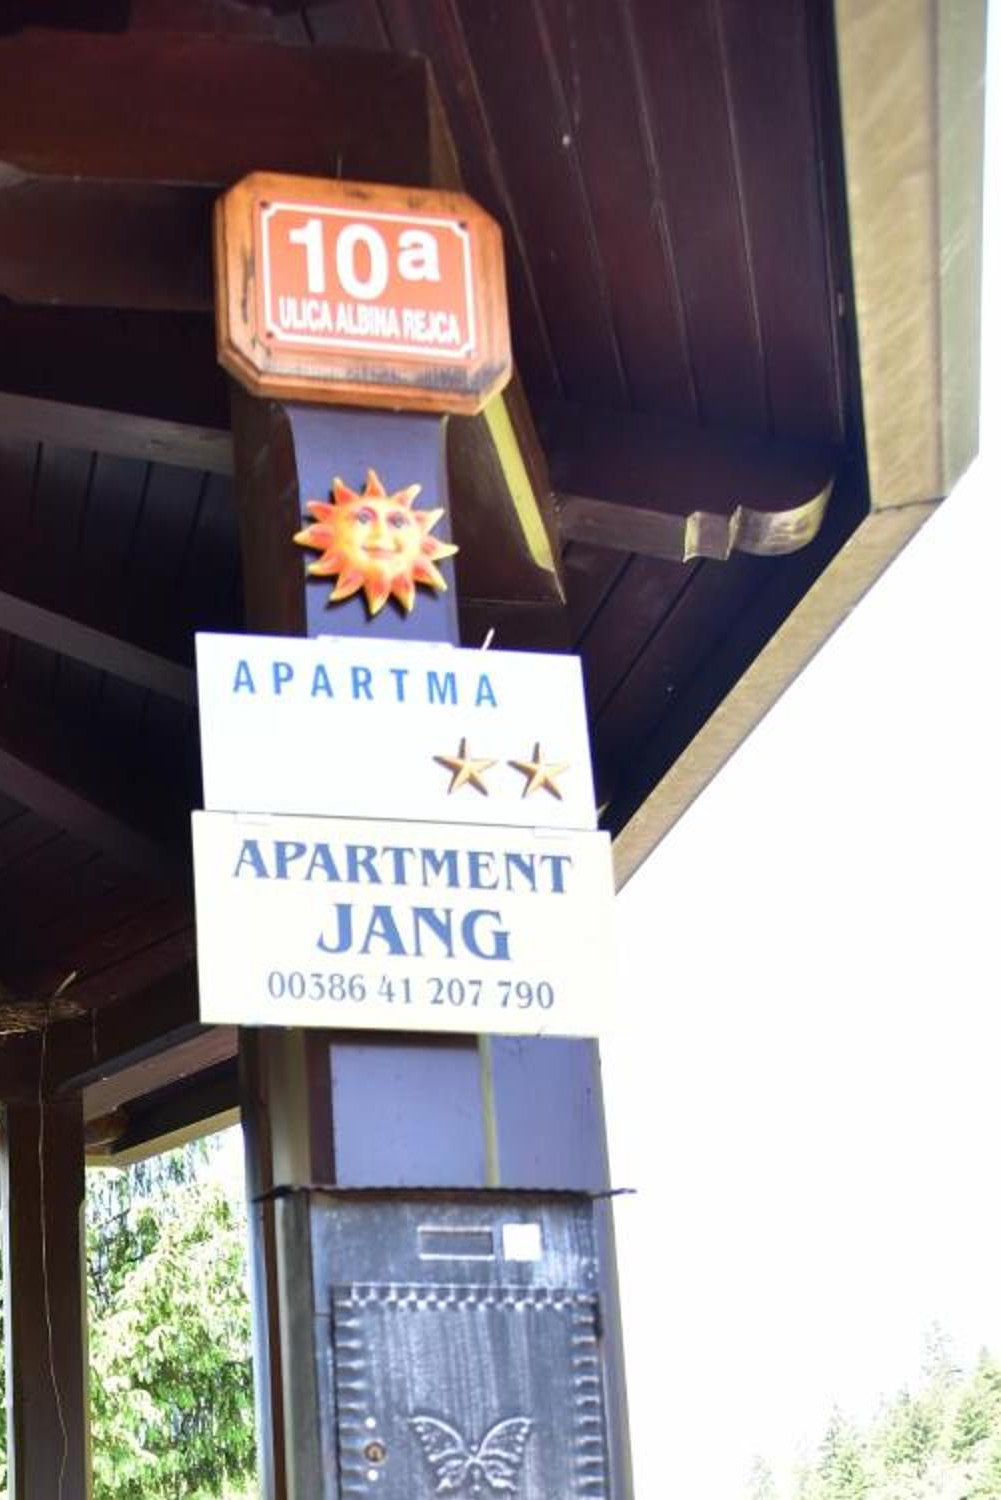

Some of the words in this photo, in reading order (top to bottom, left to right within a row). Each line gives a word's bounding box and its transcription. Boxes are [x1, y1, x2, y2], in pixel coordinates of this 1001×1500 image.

[289, 219, 440, 300] 10a
[278, 296, 333, 331] ULICA
[336, 302, 400, 337] ALBINA
[402, 308, 460, 344] REJCA
[232, 660, 498, 708] APARTMA
[232, 839, 574, 894] APARTMENT
[316, 903, 511, 961] JANG
[267, 971, 366, 1004] 00386
[378, 974, 412, 1005] 41
[429, 977, 483, 1008] 207
[498, 981, 555, 1010] 790
